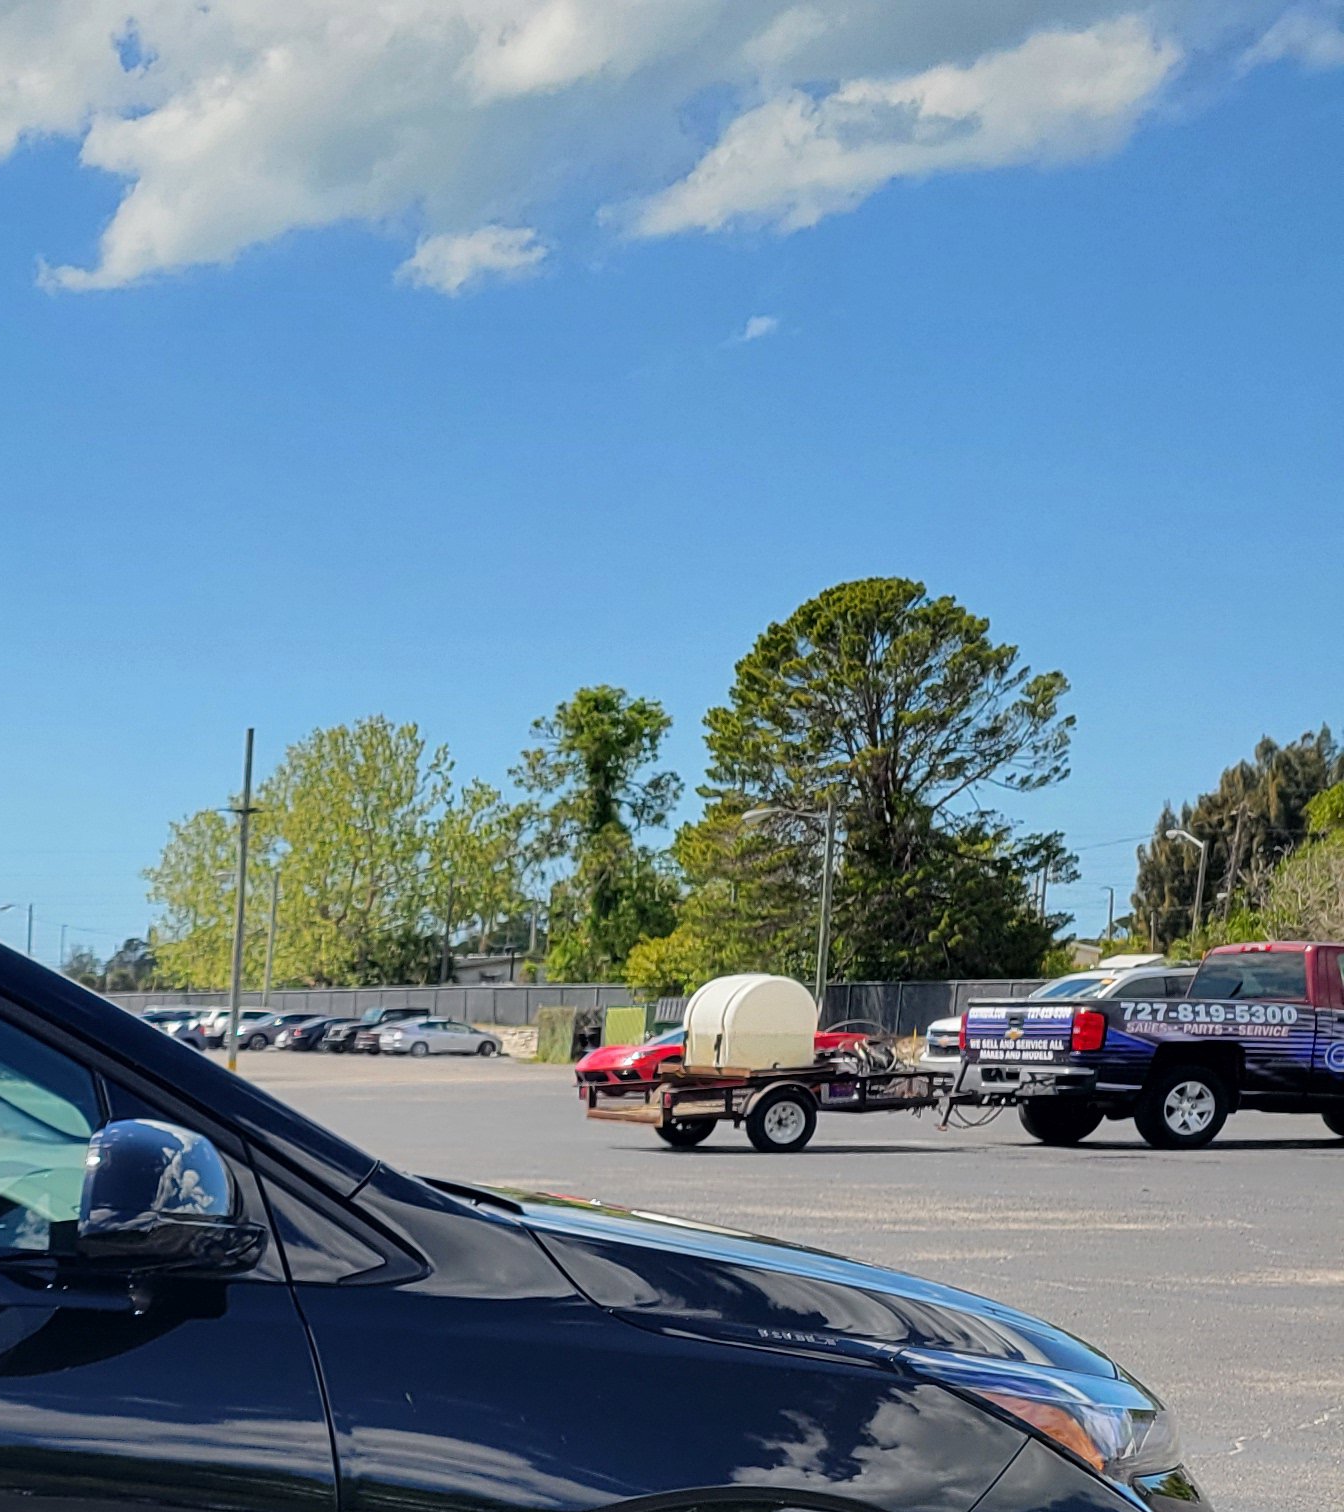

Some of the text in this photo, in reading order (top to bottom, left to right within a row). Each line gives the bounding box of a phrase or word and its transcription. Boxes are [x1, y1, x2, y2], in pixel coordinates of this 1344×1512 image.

[1120, 1002, 1298, 1024] 727-819-5300
[1125, 1022, 1291, 1037] SALES PARTS SERVICE
[970, 1039, 1064, 1050] WE SELL AND SERVICE ALL
[980, 1050, 1053, 1061] MAKES AND MODELS
